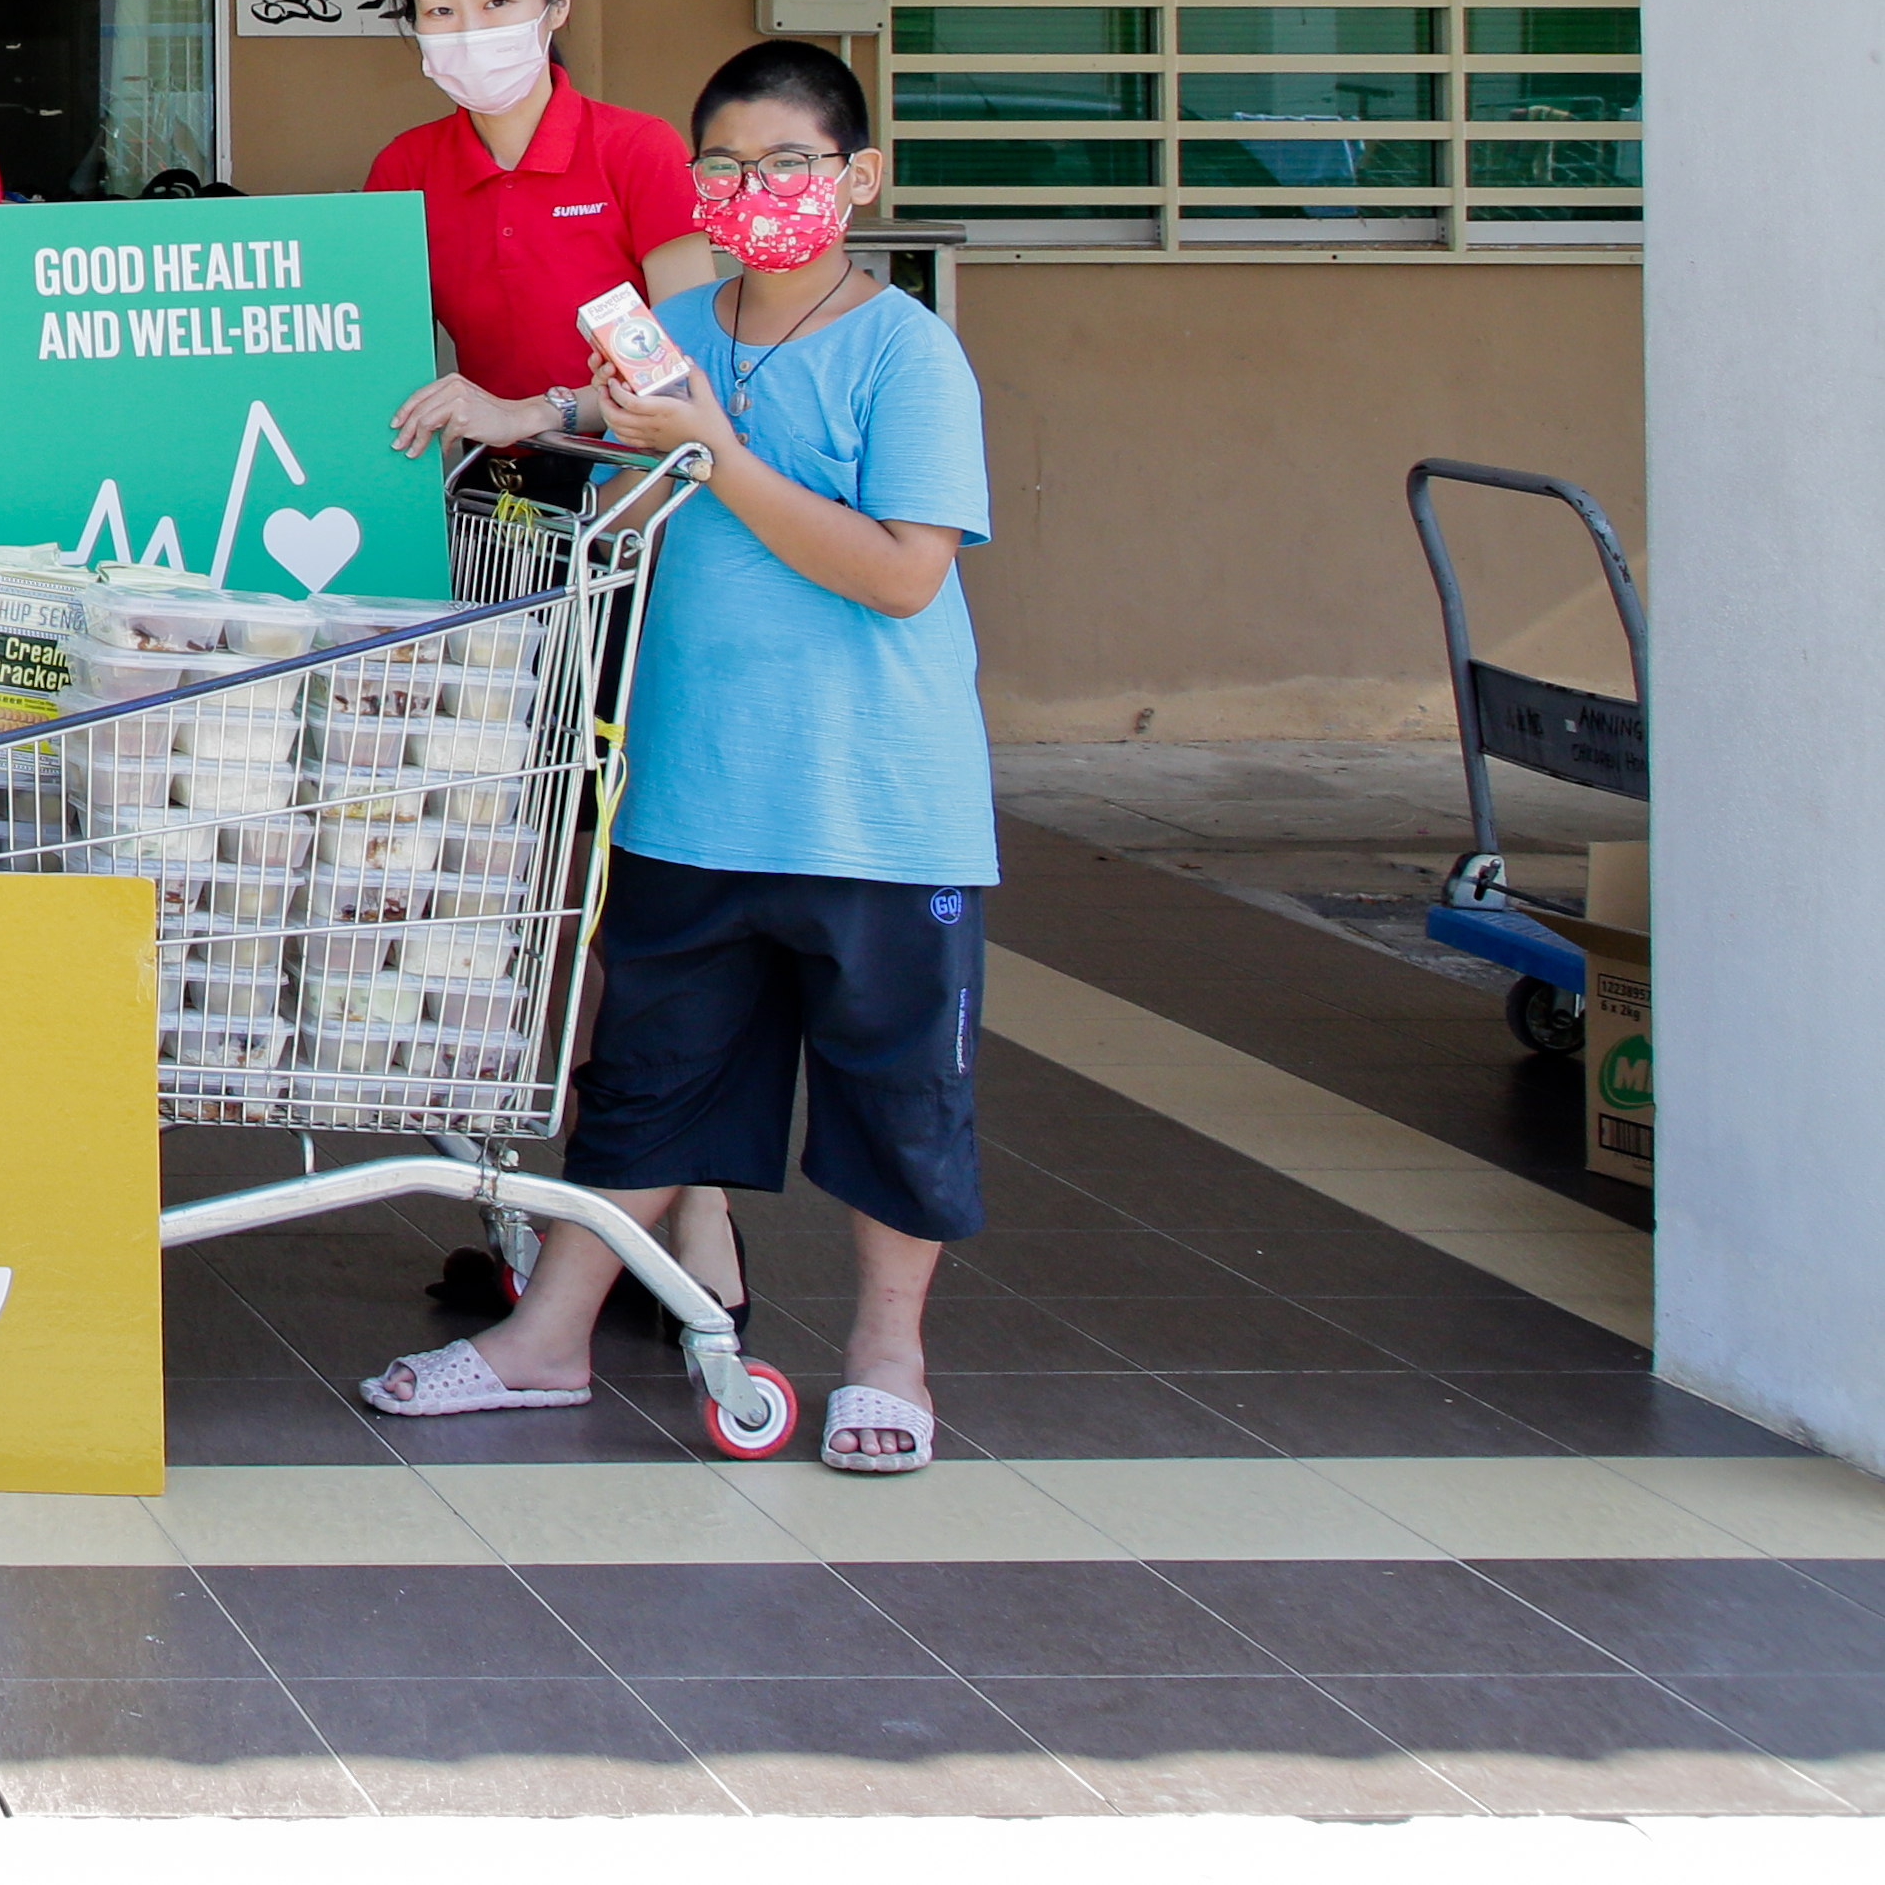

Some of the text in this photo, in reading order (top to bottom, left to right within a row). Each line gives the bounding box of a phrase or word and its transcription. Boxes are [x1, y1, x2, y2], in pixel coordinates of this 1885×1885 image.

[552, 201, 604, 218] SUNWAY
[34, 239, 303, 297] GOOD HEALTH
[38, 302, 363, 361] AND WELL-BEING
